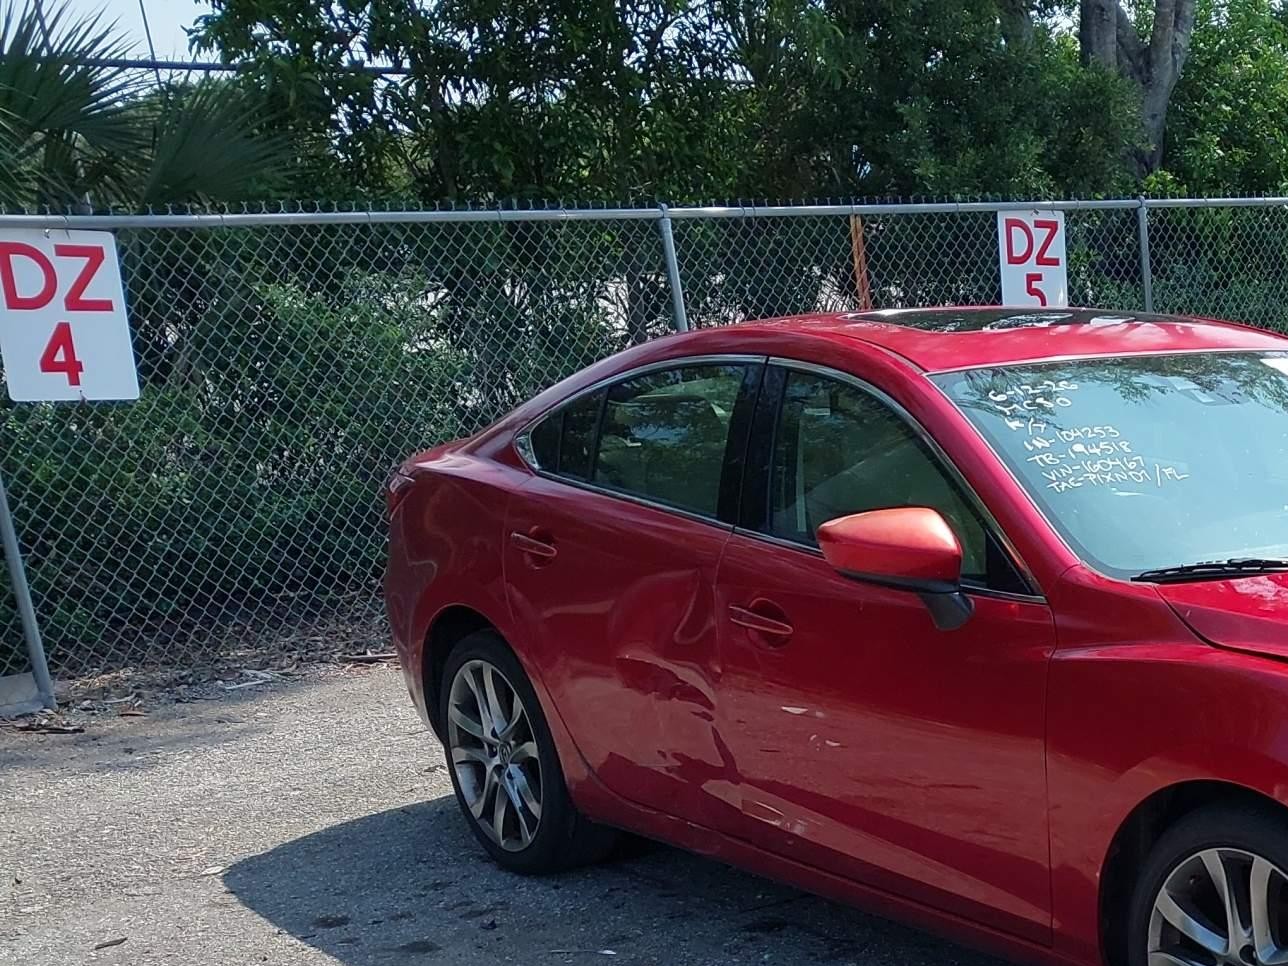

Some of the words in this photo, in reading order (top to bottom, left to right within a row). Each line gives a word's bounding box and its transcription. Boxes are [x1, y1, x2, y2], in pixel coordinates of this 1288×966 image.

[1005, 218, 1060, 266] DZ
[0, 241, 114, 311] DZ
[1025, 273, 1047, 306] 5
[40, 321, 84, 386] 4
